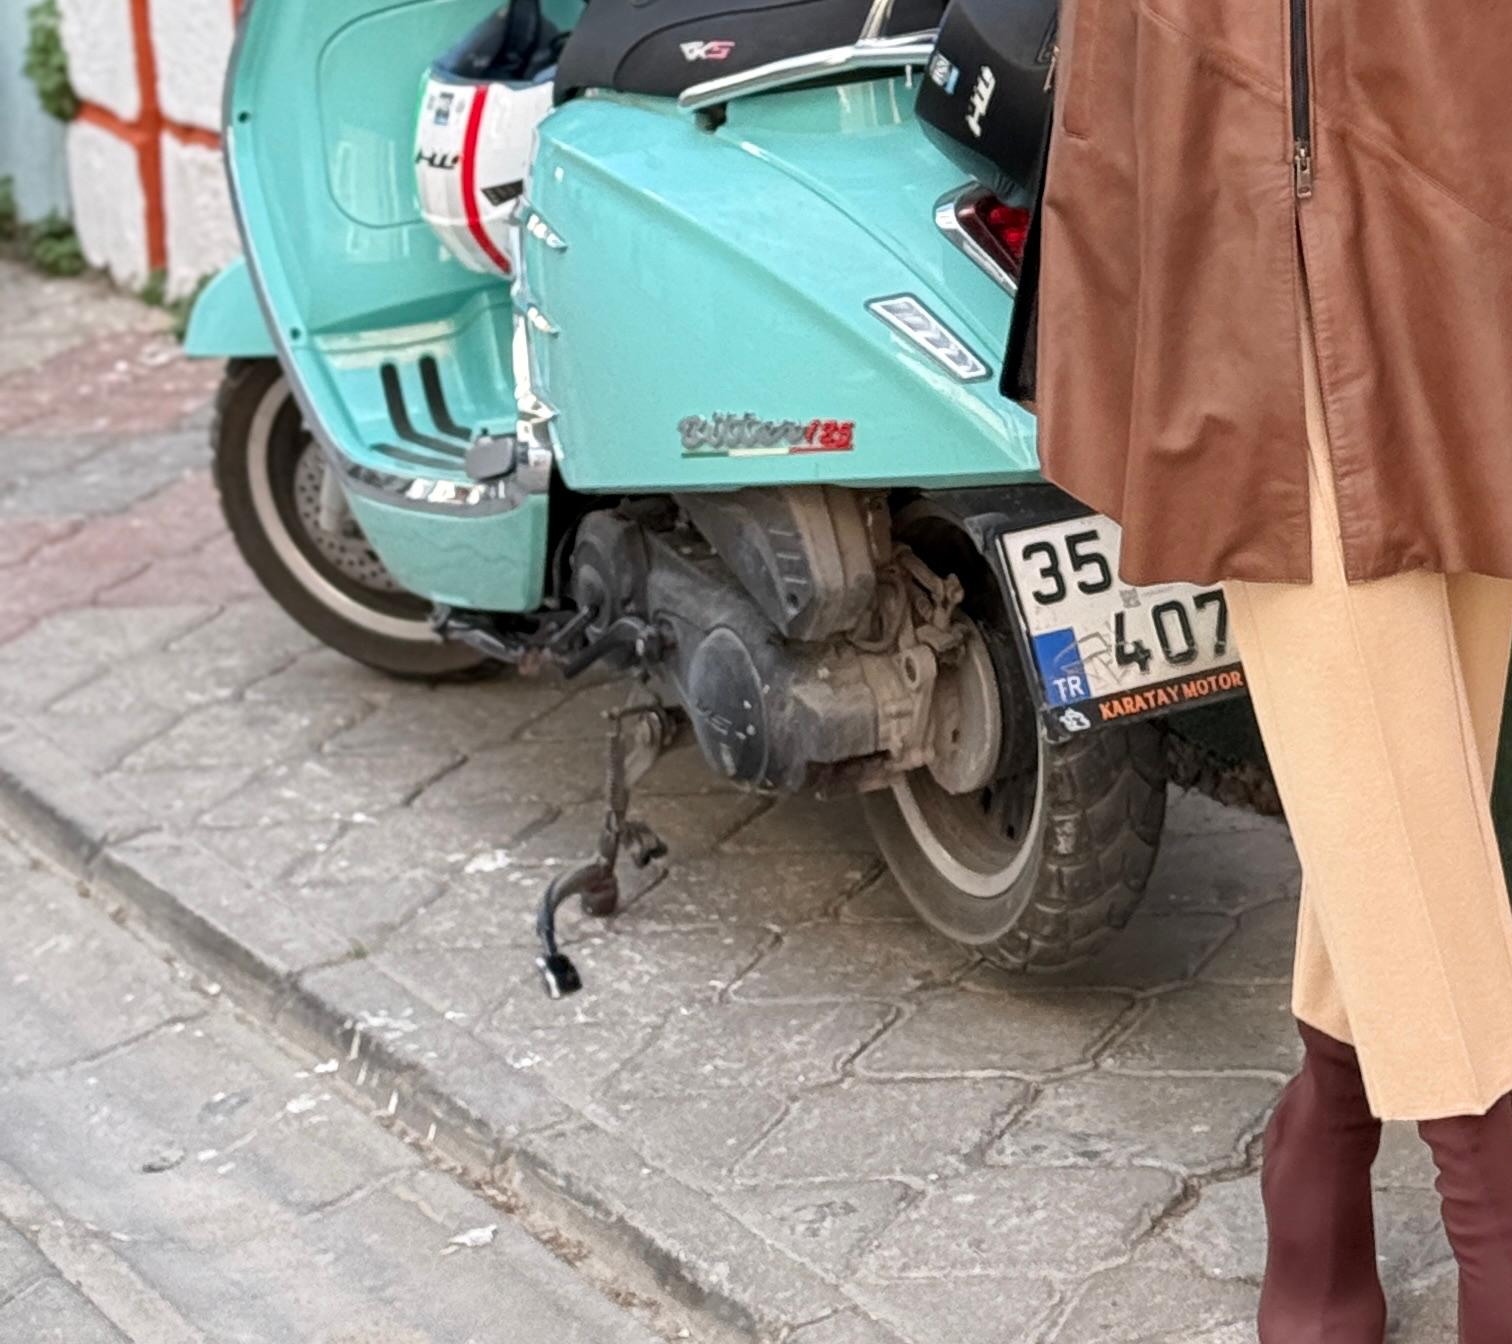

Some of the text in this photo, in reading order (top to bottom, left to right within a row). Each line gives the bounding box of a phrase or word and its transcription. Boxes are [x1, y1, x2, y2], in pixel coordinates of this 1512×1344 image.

[1021, 529, 1113, 606] 35
[1113, 588, 1229, 674] 407
[1054, 675, 1086, 702] TR
[1098, 670, 1245, 721] KARATAY MOTOR
